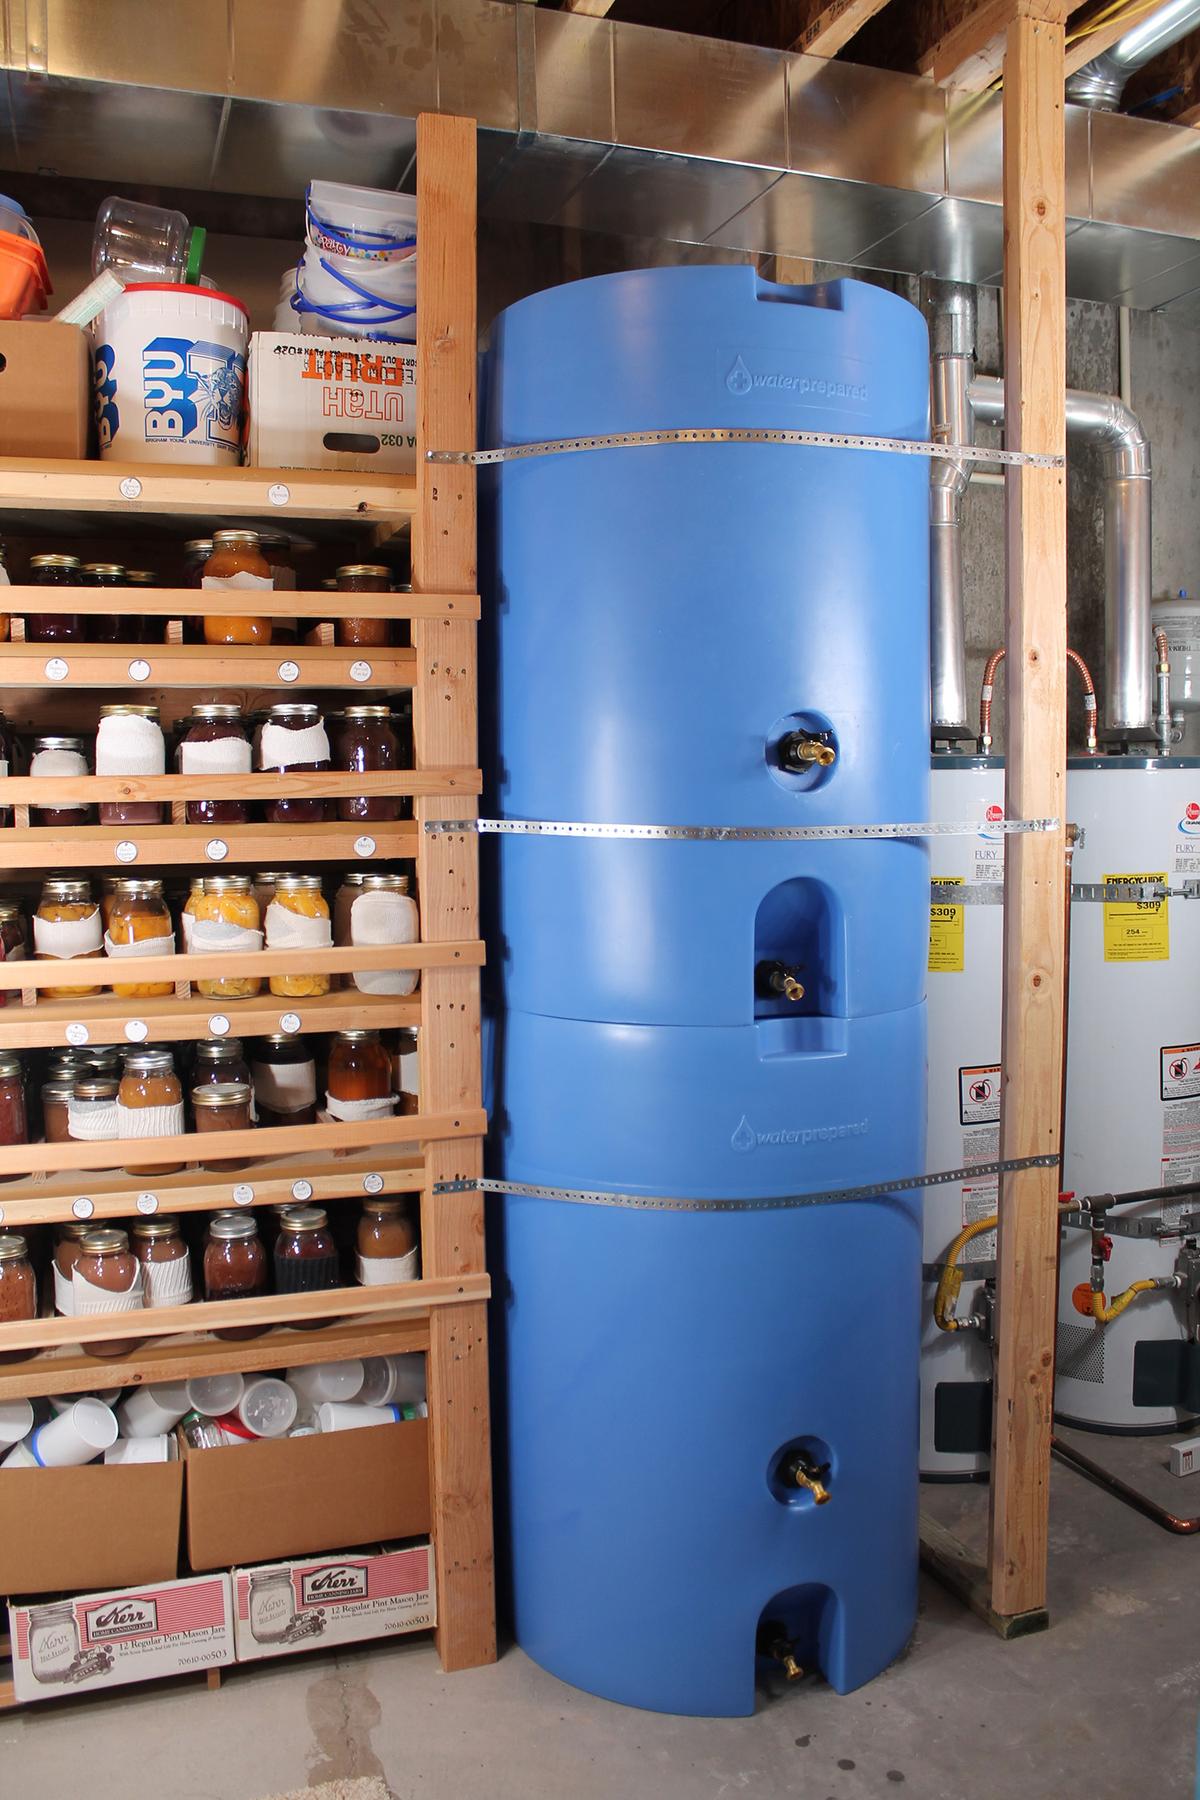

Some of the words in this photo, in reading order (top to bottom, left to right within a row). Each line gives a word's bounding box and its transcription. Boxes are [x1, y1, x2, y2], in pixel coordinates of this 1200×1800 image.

[301, 349, 404, 387] FRUIT
[142, 340, 194, 438] BYU
[752, 374, 869, 401] waterprepared
[381, 434, 403, 447] 032
[975, 850, 997, 860] FURY
[1176, 844, 1194, 853] FURY
[930, 907, 956, 917] $309
[1137, 901, 1161, 910] $309
[755, 1117, 871, 1145] waterprepared
[311, 1569, 357, 1592] Kerr
[96, 1603, 146, 1627] Kerr
[331, 1607, 340, 1615] 12
[342, 1602, 370, 1613] Regular
[372, 1600, 388, 1608] Pint
[389, 1596, 414, 1605] Mason
[416, 1593, 429, 1602] Jars
[119, 1643, 129, 1651] 12
[131, 1638, 162, 1650] Regular
[163, 1633, 181, 1643] Pint
[182, 1629, 209, 1639] Mason
[210, 1625, 226, 1636] Jars
[178, 1650, 228, 1666] 70610-00503
